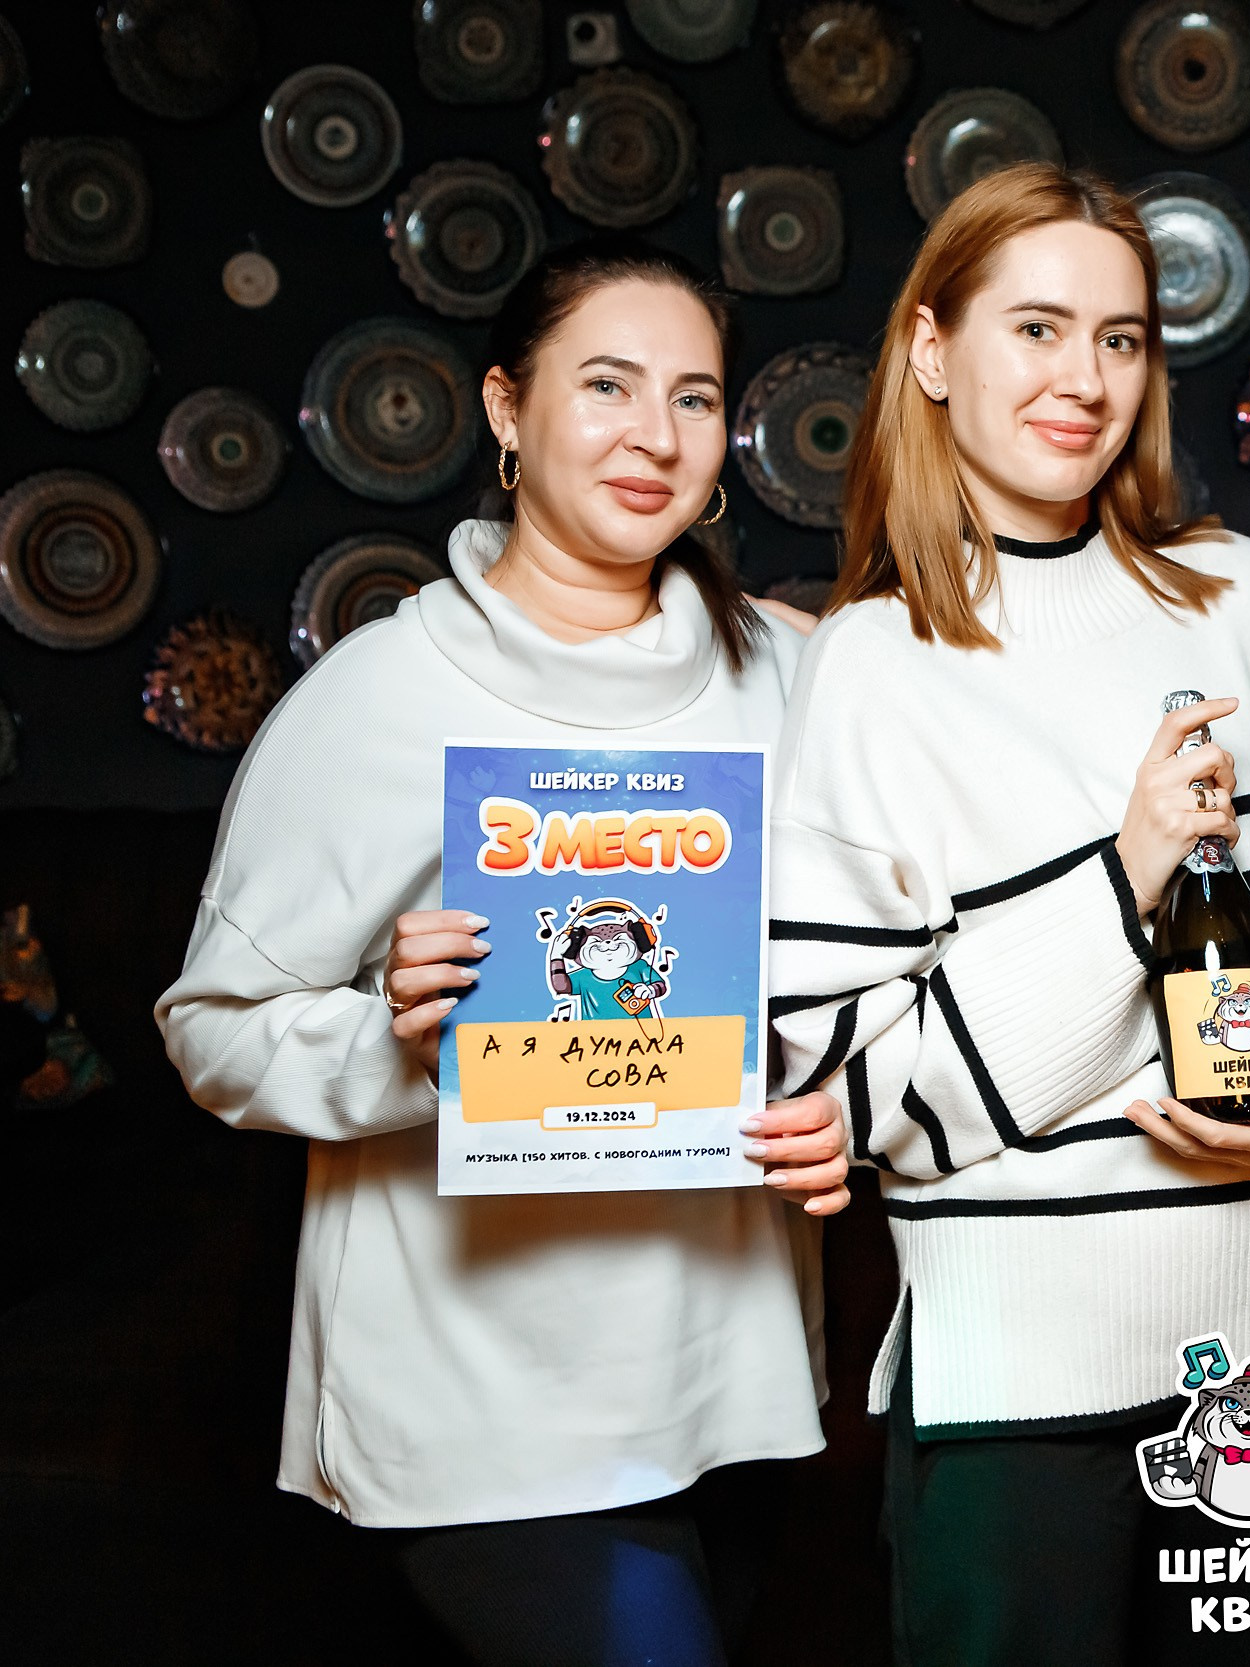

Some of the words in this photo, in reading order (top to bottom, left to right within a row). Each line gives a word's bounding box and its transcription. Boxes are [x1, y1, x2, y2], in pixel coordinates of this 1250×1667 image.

[530, 768, 619, 791] ШЕЙКЕР
[626, 772, 685, 791] КВИЗ
[484, 806, 535, 870] 3
[542, 815, 725, 870] МЕСТО
[482, 1034, 502, 1059] А
[521, 1037, 537, 1055] Я
[586, 1063, 667, 1088] СОВА
[566, 1111, 636, 1123] 19.12.2024
[465, 1152, 518, 1163] МУЗЫКА
[522, 1152, 546, 1162] [150
[550, 1151, 590, 1161] ХИТОВ.
[594, 1151, 601, 1160] С
[604, 1148, 682, 1160] НОВОГОДНИМ
[686, 1147, 730, 1158] ТУРОМ]
